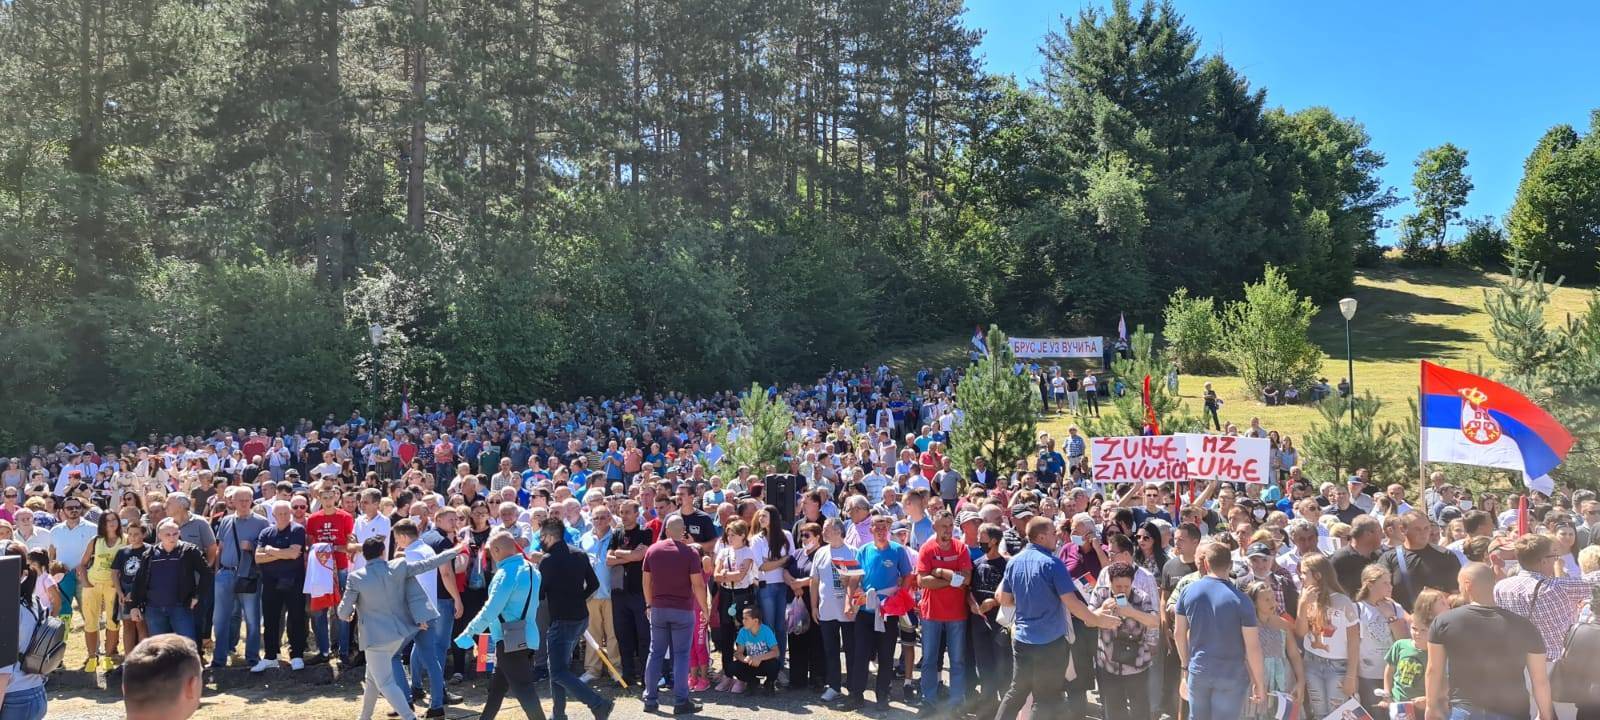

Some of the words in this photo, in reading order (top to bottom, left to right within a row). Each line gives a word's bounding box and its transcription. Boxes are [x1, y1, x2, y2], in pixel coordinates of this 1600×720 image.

[1014, 342, 1036, 353] БРУС
[1049, 342, 1059, 353] УЗ
[1062, 341, 1097, 353] ВУЧИЋА
[1202, 435, 1236, 454] MZ
